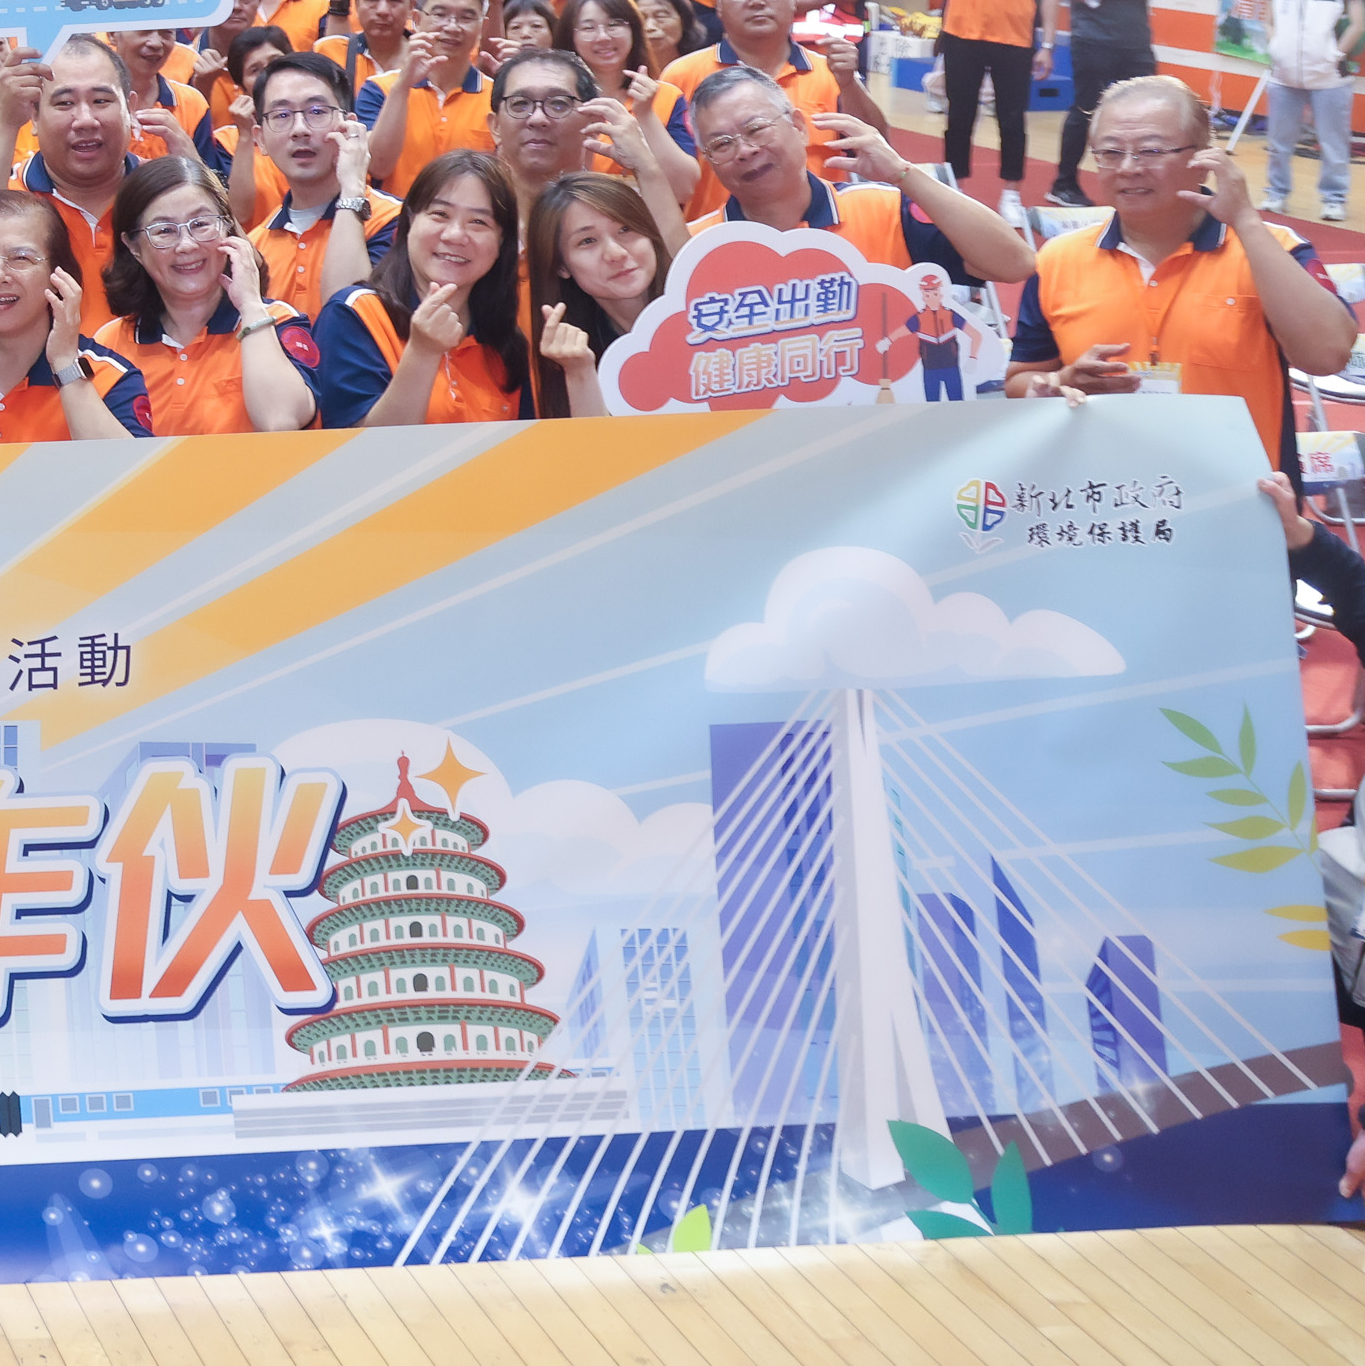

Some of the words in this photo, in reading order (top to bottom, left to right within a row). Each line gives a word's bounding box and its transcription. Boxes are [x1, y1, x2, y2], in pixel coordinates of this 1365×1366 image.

[687, 273, 859, 342] 安全出勤
[689, 331, 863, 399] 健康同行
[1011, 474, 1186, 517] 新北市政府
[1026, 519, 1176, 548] 環境保護局
